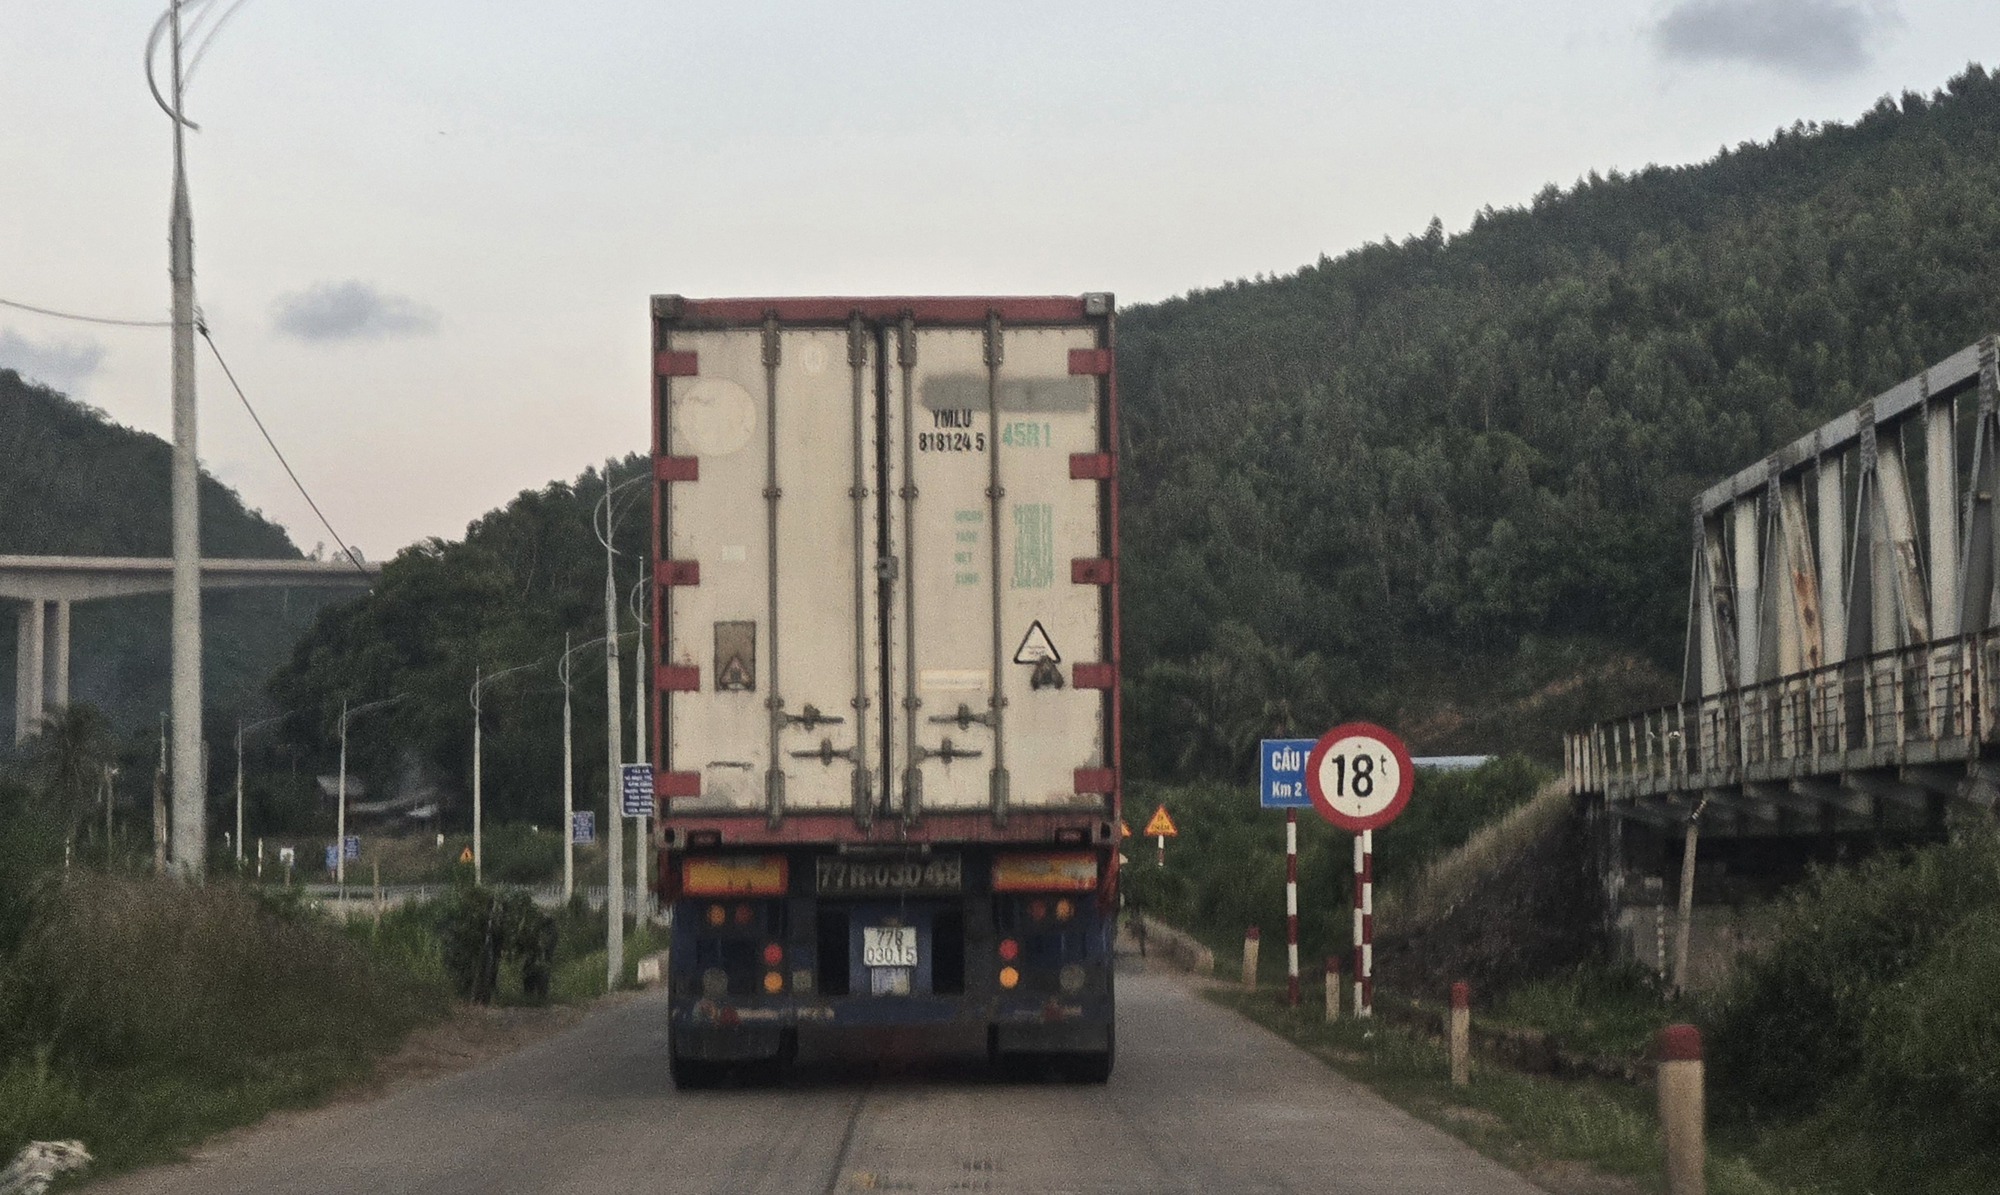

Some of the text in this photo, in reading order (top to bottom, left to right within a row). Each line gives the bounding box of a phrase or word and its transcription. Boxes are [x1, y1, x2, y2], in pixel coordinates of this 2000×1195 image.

[932, 409, 972, 428] YMLU
[918, 433, 971, 452] 818124
[1003, 422, 1052, 447] 45R1
[1272, 781, 1303, 798] Km 2
